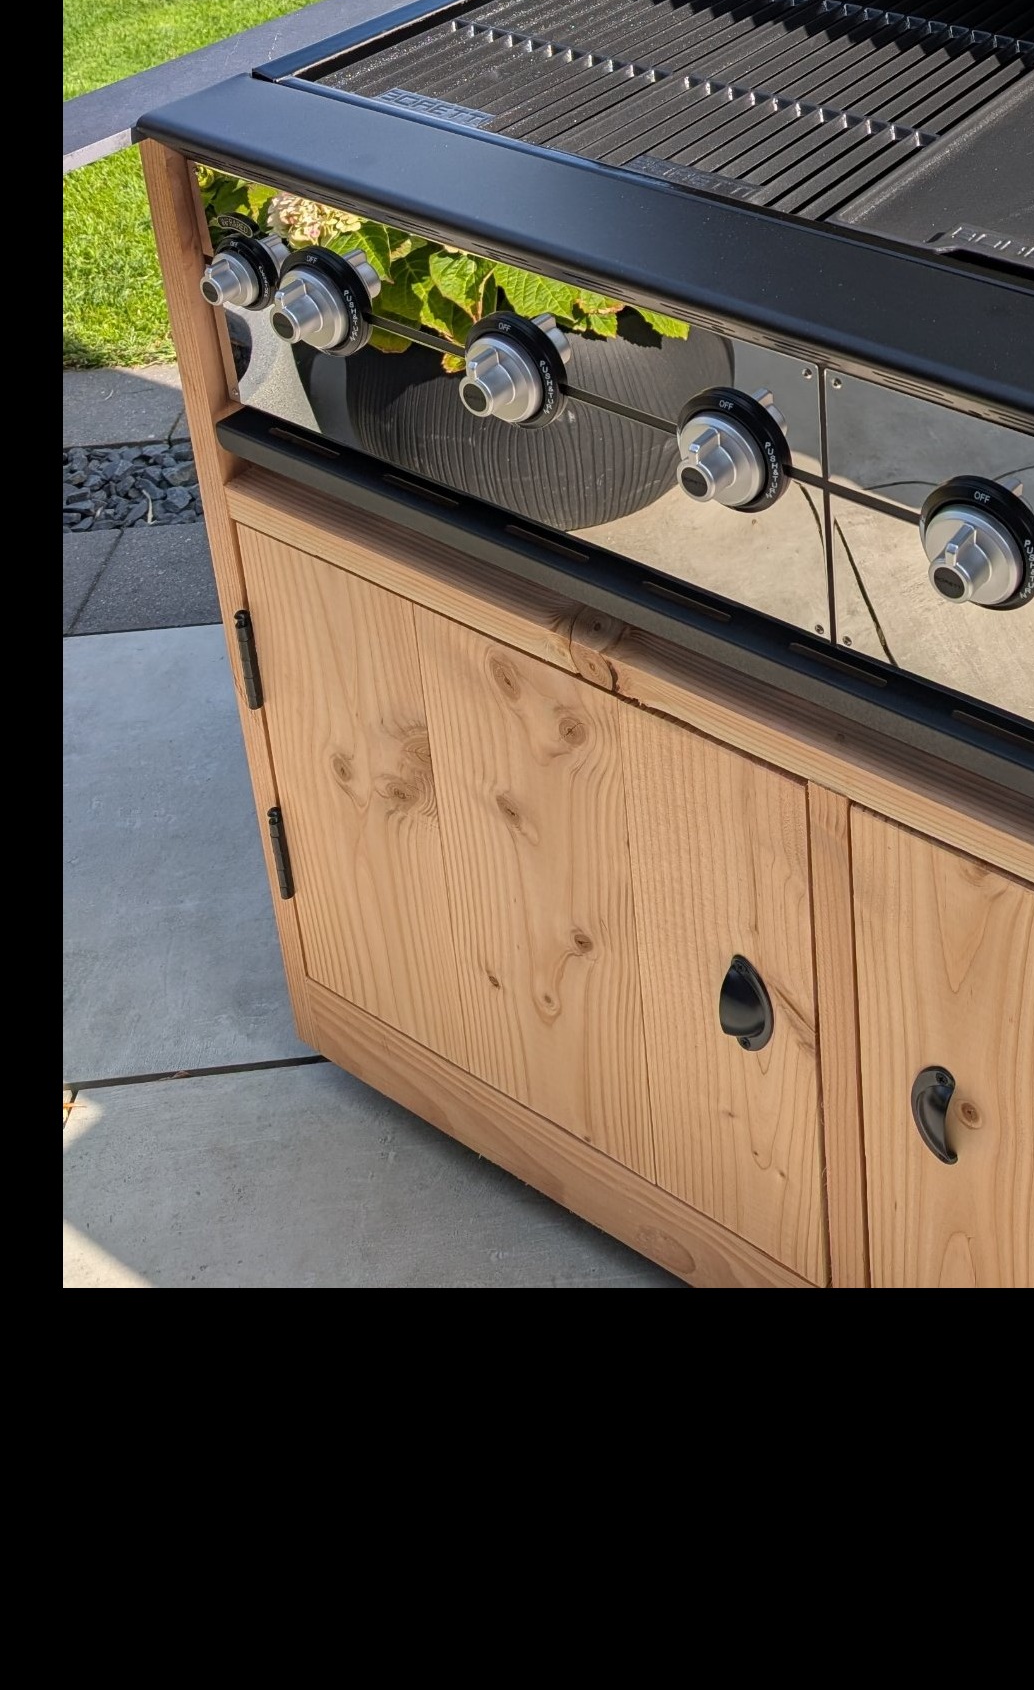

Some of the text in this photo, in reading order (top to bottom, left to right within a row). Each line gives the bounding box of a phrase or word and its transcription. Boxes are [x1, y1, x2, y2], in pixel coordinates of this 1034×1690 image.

[306, 254, 318, 264] OFF
[498, 322, 511, 332] OFF
[718, 399, 734, 410] OFF
[973, 490, 991, 503] OFF
